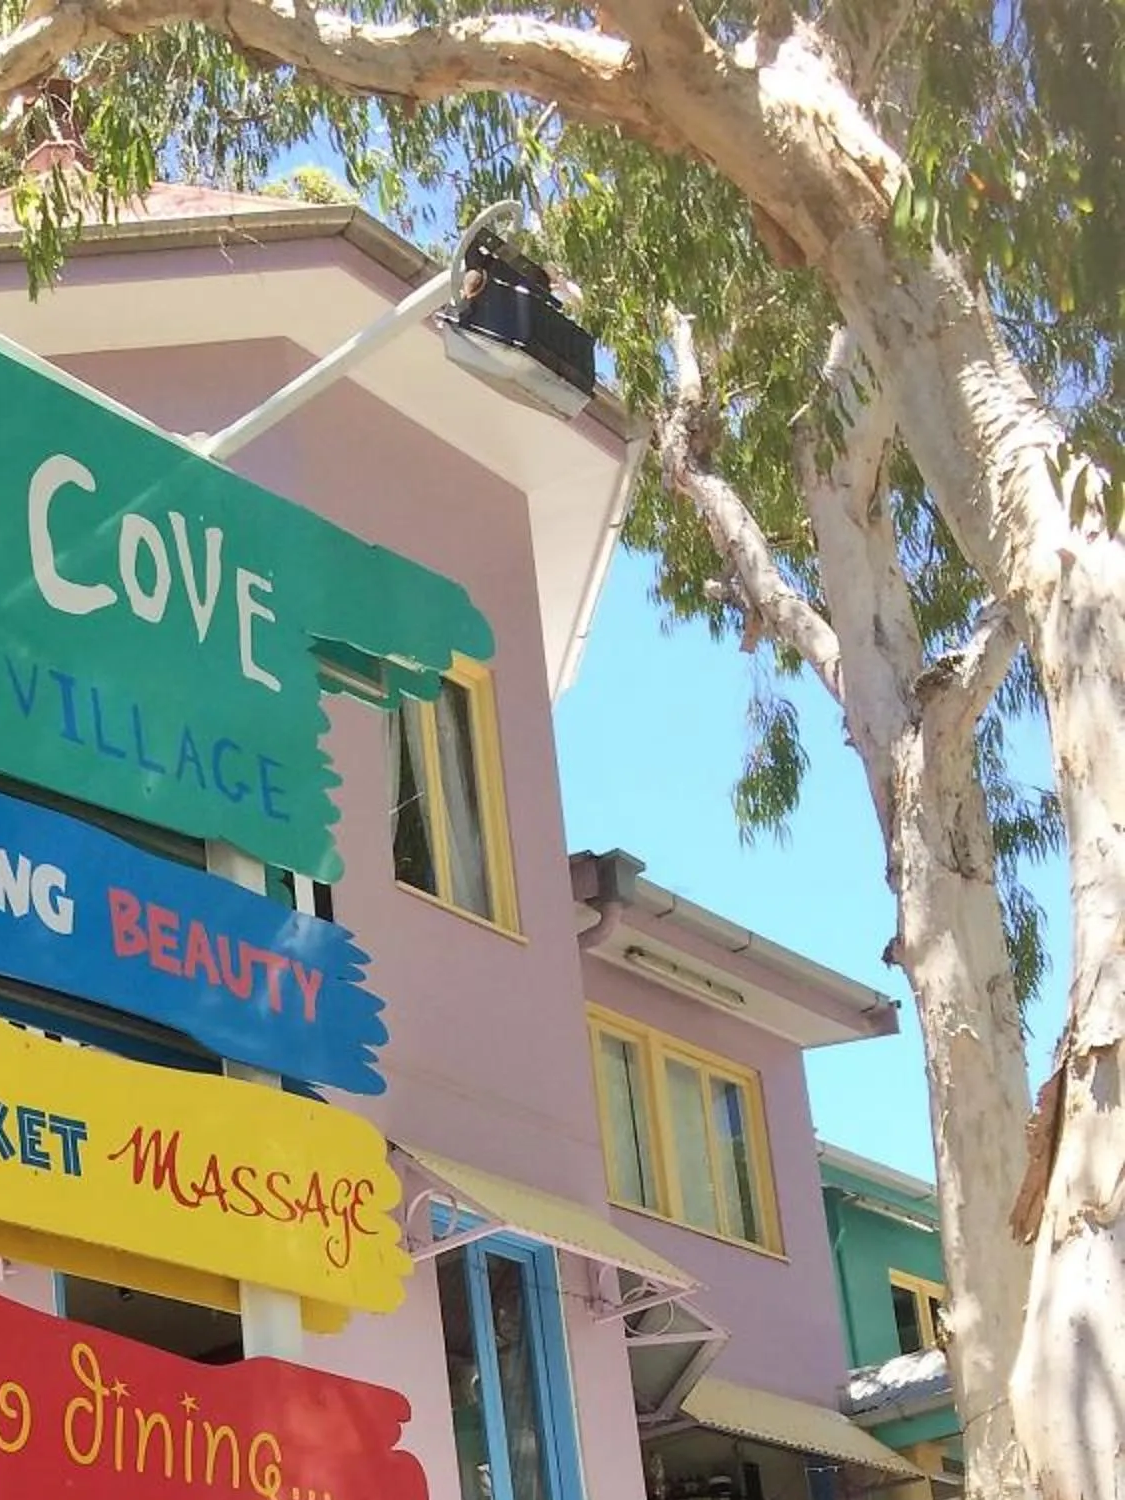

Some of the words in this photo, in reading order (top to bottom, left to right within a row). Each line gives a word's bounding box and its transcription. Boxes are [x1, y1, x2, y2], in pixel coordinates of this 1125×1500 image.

[27, 453, 281, 693] COVE
[5, 656, 294, 825] VILLAGE
[106, 885, 326, 1025] BEAUTY
[108, 1125, 379, 1269] MASSAGE
